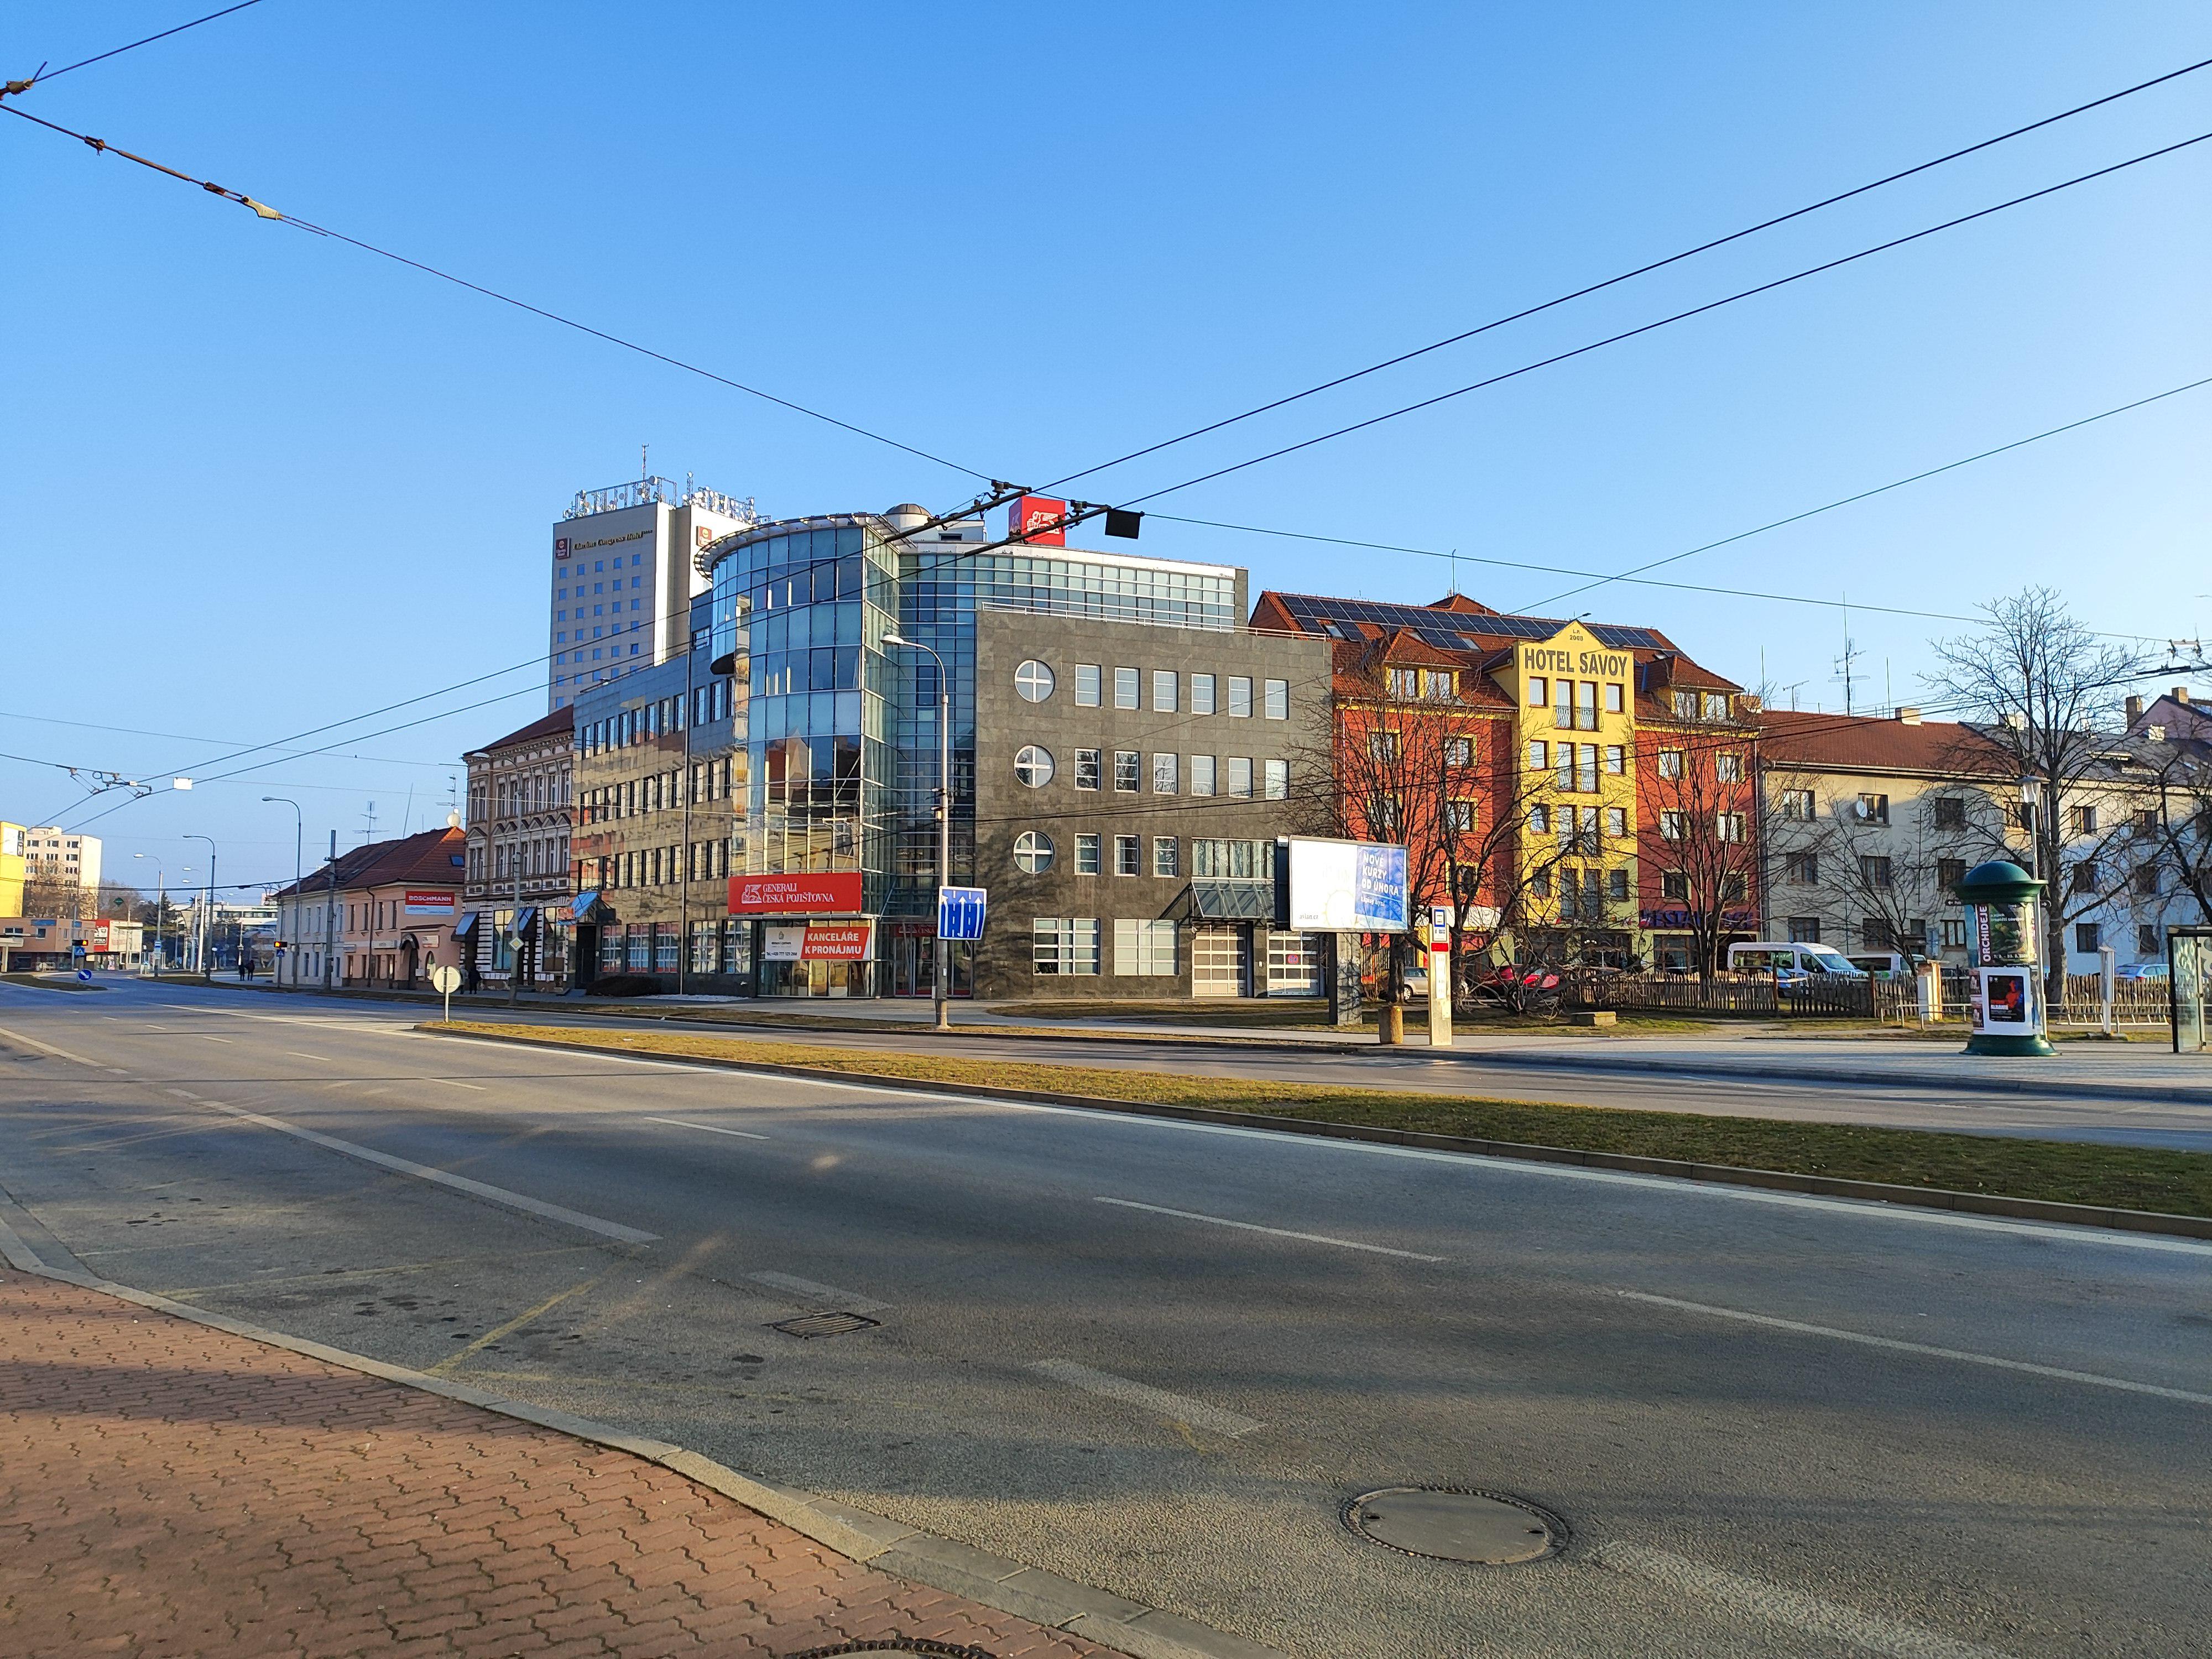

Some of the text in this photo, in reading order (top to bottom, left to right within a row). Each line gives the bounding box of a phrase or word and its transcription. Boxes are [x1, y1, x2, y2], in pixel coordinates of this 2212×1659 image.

[1525, 648, 1628, 677] HOTEL SAVOY
[1363, 852, 1385, 868] NOVÉ
[1362, 864, 1387, 880] KURZY
[763, 883, 797, 893] GENERALI
[1361, 878, 1399, 896] OD ÚNORA
[763, 892, 835, 904] ČESKÁ POJIŠŤOVNA
[807, 931, 859, 942] KANCELÁŘE
[1980, 906, 1991, 962] ORCHIDEJE
[805, 943, 862, 954] K PRONÁJMU
